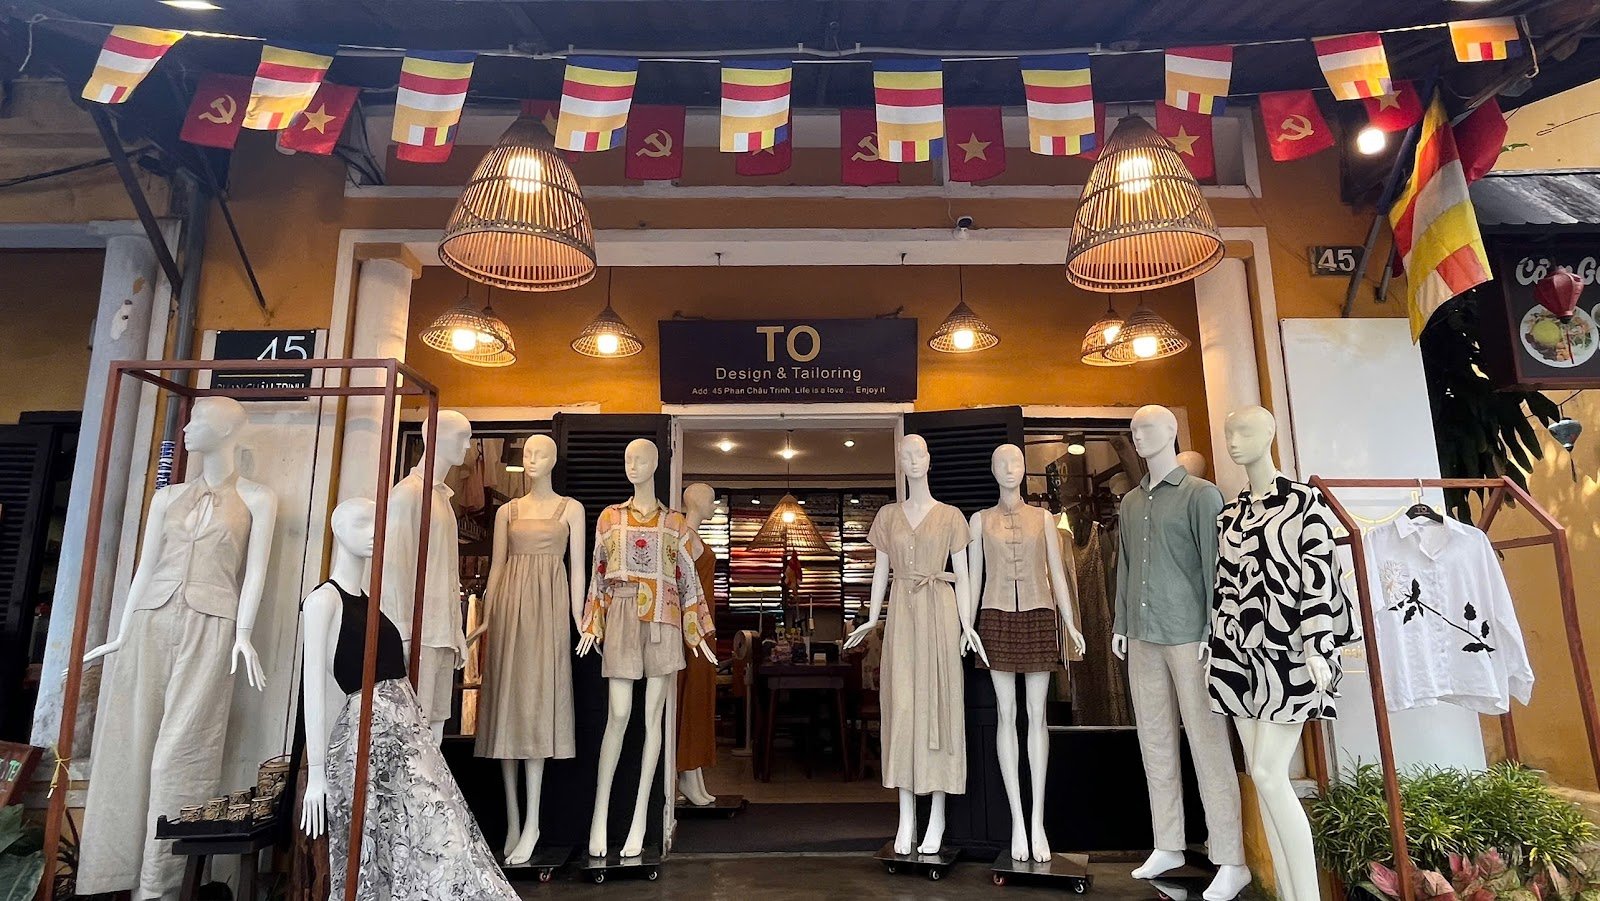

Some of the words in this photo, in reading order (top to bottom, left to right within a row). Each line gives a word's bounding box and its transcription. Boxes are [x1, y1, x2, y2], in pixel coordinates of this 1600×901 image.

[1318, 249, 1356, 271] 45
[756, 325, 821, 362] TO
[715, 367, 772, 382] Design
[776, 366, 787, 379] &
[791, 366, 862, 382] Tailoring
[712, 387, 723, 395] 45
[724, 387, 745, 395] Phan
[746, 386, 768, 395] Châu
[795, 386, 810, 394] Life
[812, 386, 818, 394] is
[856, 386, 878, 395] Enjoy
[880, 386, 886, 394] it
